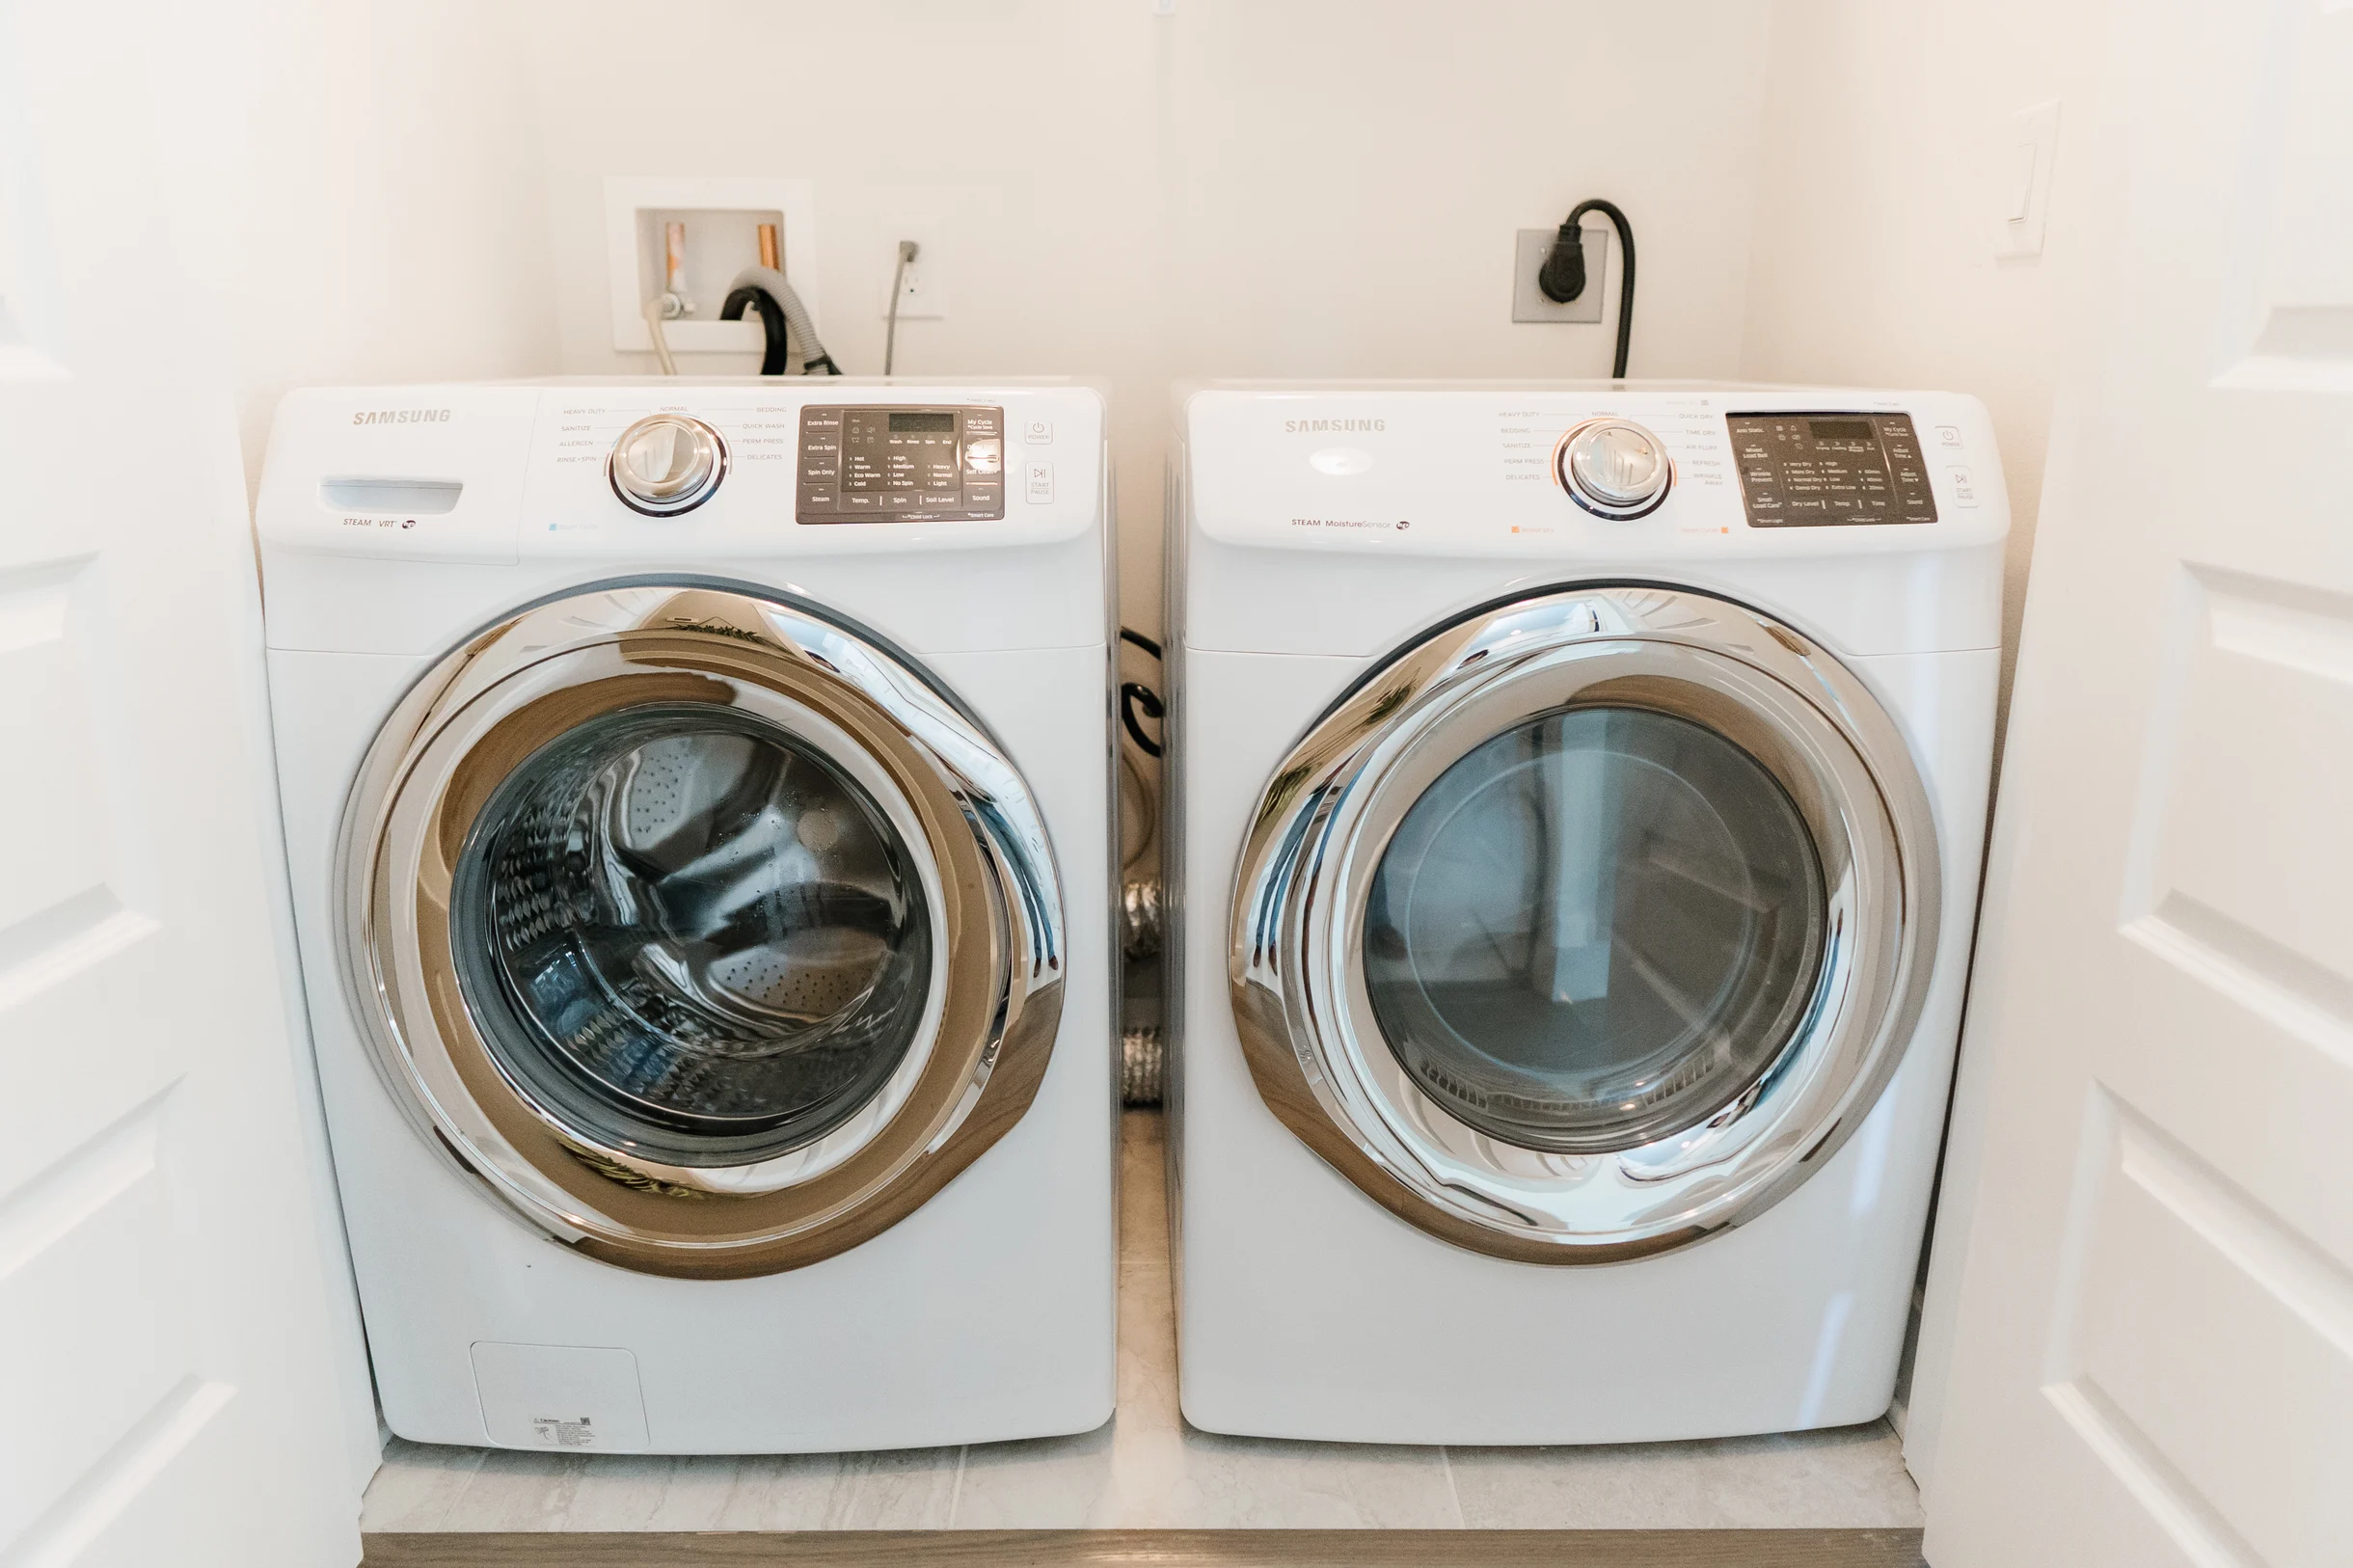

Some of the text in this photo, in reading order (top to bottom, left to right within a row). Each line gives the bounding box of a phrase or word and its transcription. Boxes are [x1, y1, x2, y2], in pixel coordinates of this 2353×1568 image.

[353, 409, 451, 425] SAMSUNG
[1285, 419, 1386, 433] SAMSUNG
[343, 518, 372, 527] STEAM
[1291, 518, 1321, 527] STEAM
[1325, 520, 1391, 528] MoistureSensor
